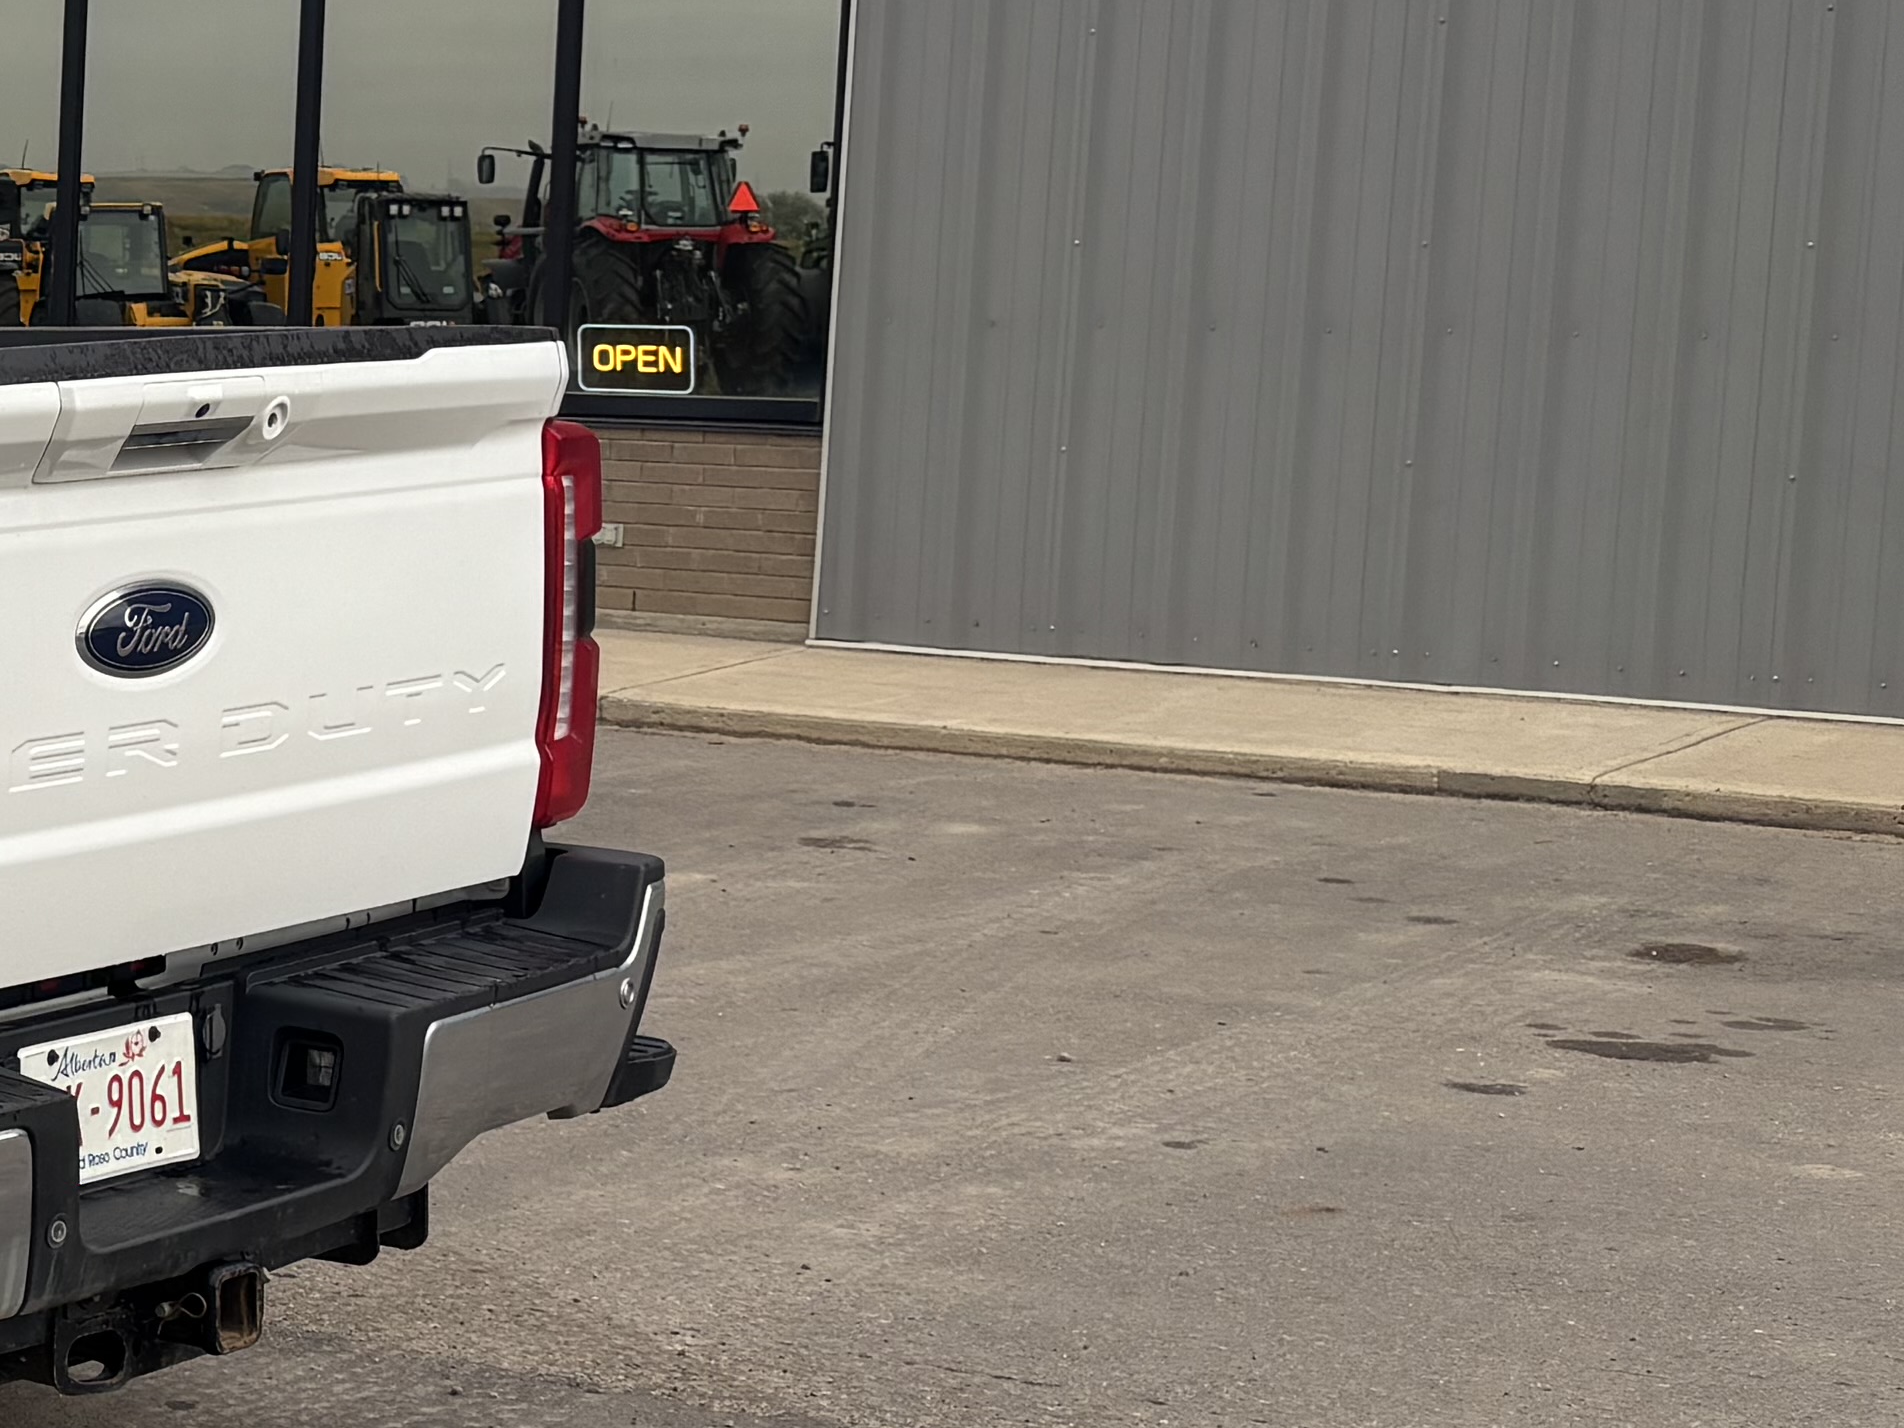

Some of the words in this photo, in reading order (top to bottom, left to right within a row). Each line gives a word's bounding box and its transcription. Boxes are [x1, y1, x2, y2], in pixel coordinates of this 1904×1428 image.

[593, 344, 682, 374] OPEN
[117, 603, 190, 657] Ford
[221, 662, 507, 757] DUTY
